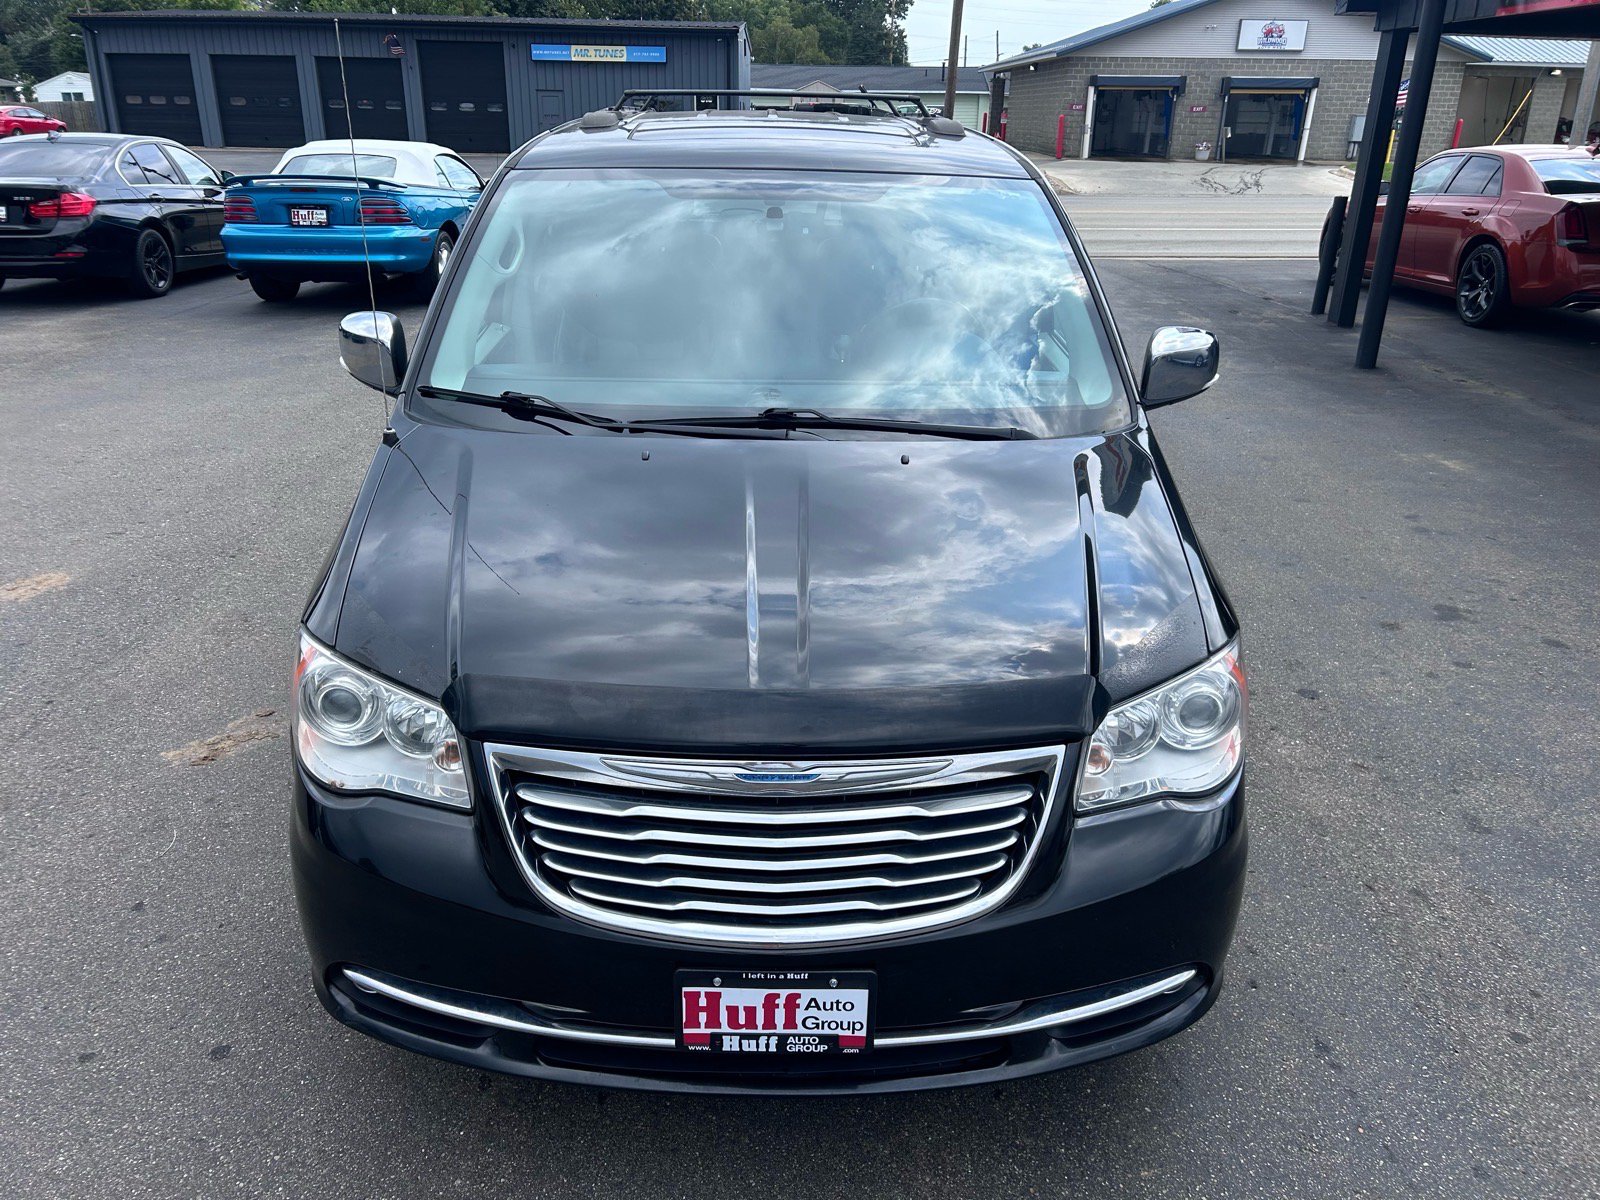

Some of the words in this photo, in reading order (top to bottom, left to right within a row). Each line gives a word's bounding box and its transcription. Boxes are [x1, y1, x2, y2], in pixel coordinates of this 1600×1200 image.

[573, 48, 592, 58] MR.
[594, 49, 625, 58] TUNES
[292, 210, 314, 220] Huff
[683, 991, 801, 1030] Huff
[804, 997, 855, 1012] Auto
[801, 1016, 864, 1034] Group
[722, 1035, 778, 1052] Huff
[786, 1036, 819, 1045] AUTO
[786, 1044, 828, 1053] GROUP
